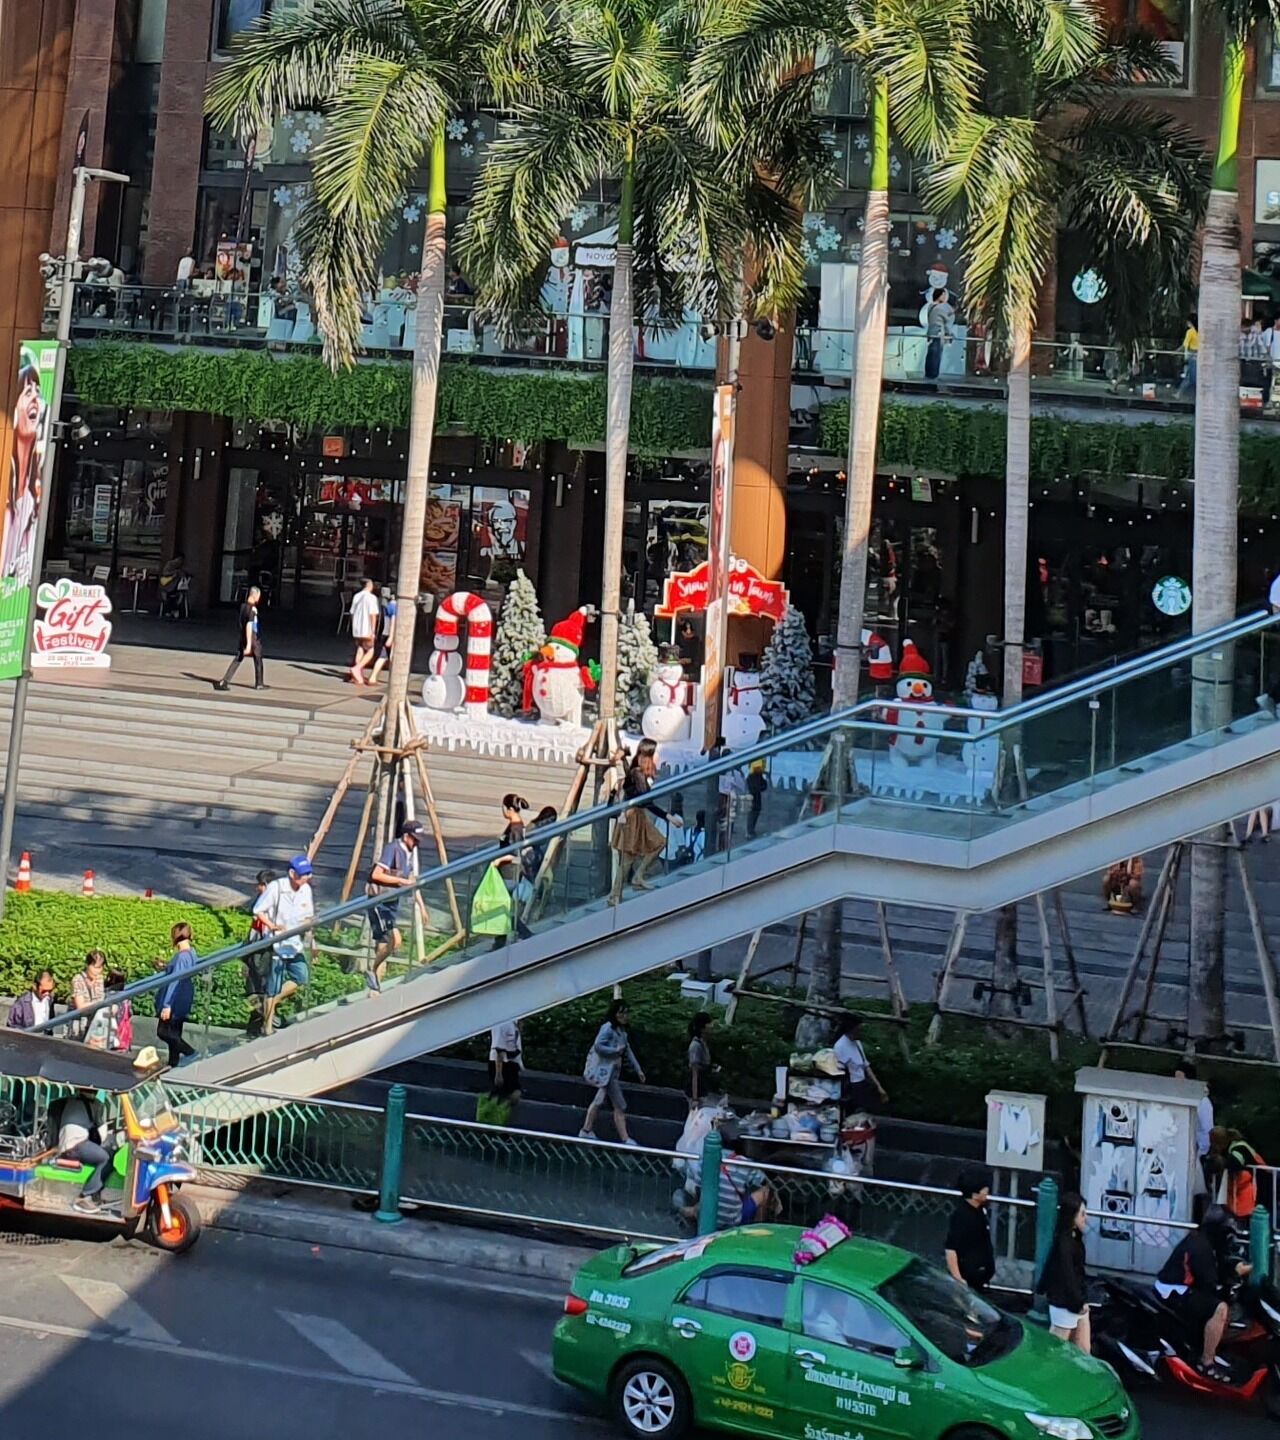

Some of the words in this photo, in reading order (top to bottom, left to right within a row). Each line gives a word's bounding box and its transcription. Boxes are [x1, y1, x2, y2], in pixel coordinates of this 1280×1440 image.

[747, 576, 775, 604] Town
[48, 598, 108, 631] Gift
[43, 632, 99, 651] Festival
